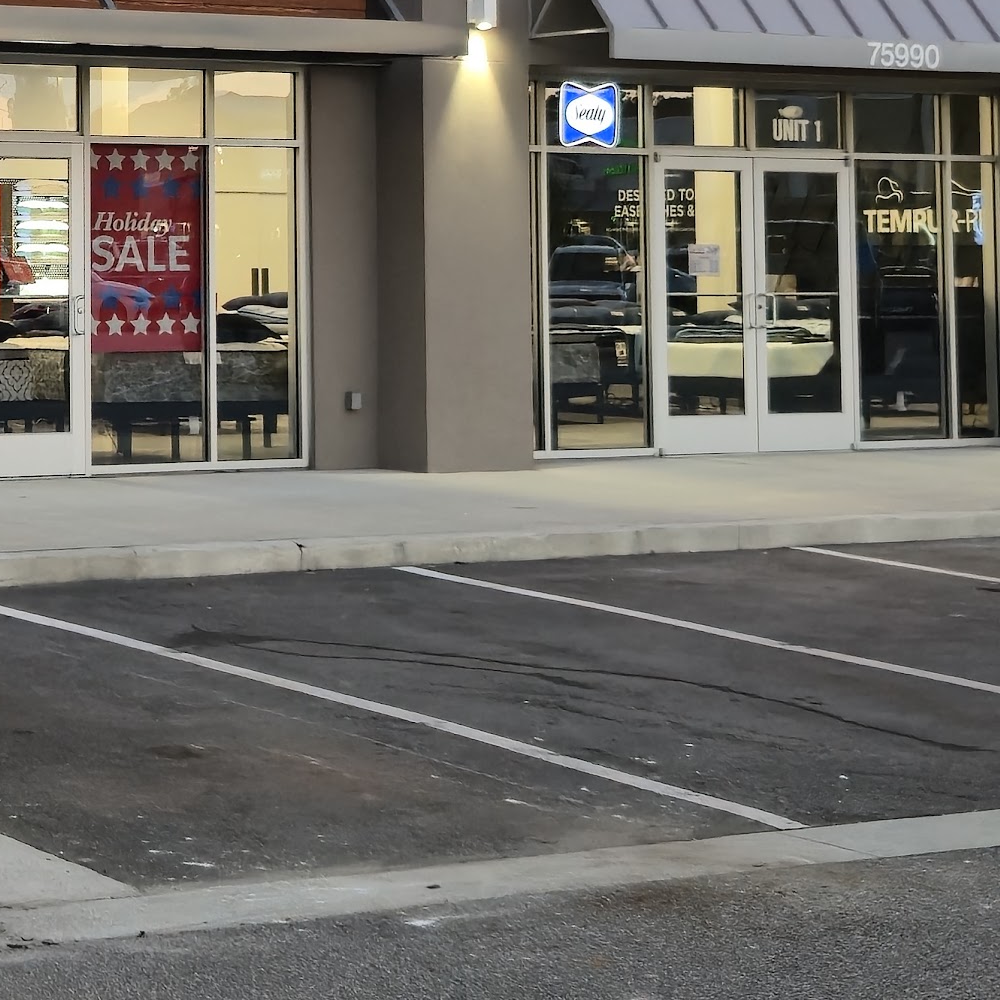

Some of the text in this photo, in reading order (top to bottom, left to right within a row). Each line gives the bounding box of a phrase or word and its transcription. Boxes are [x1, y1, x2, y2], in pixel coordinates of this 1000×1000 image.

[867, 42, 940, 69] 75990
[575, 104, 606, 125] Sealy
[772, 118, 822, 142] UNIT 1
[678, 188, 695, 201] TO
[686, 204, 695, 217] &
[92, 211, 173, 238] Holiday
[92, 235, 190, 272] SALE
